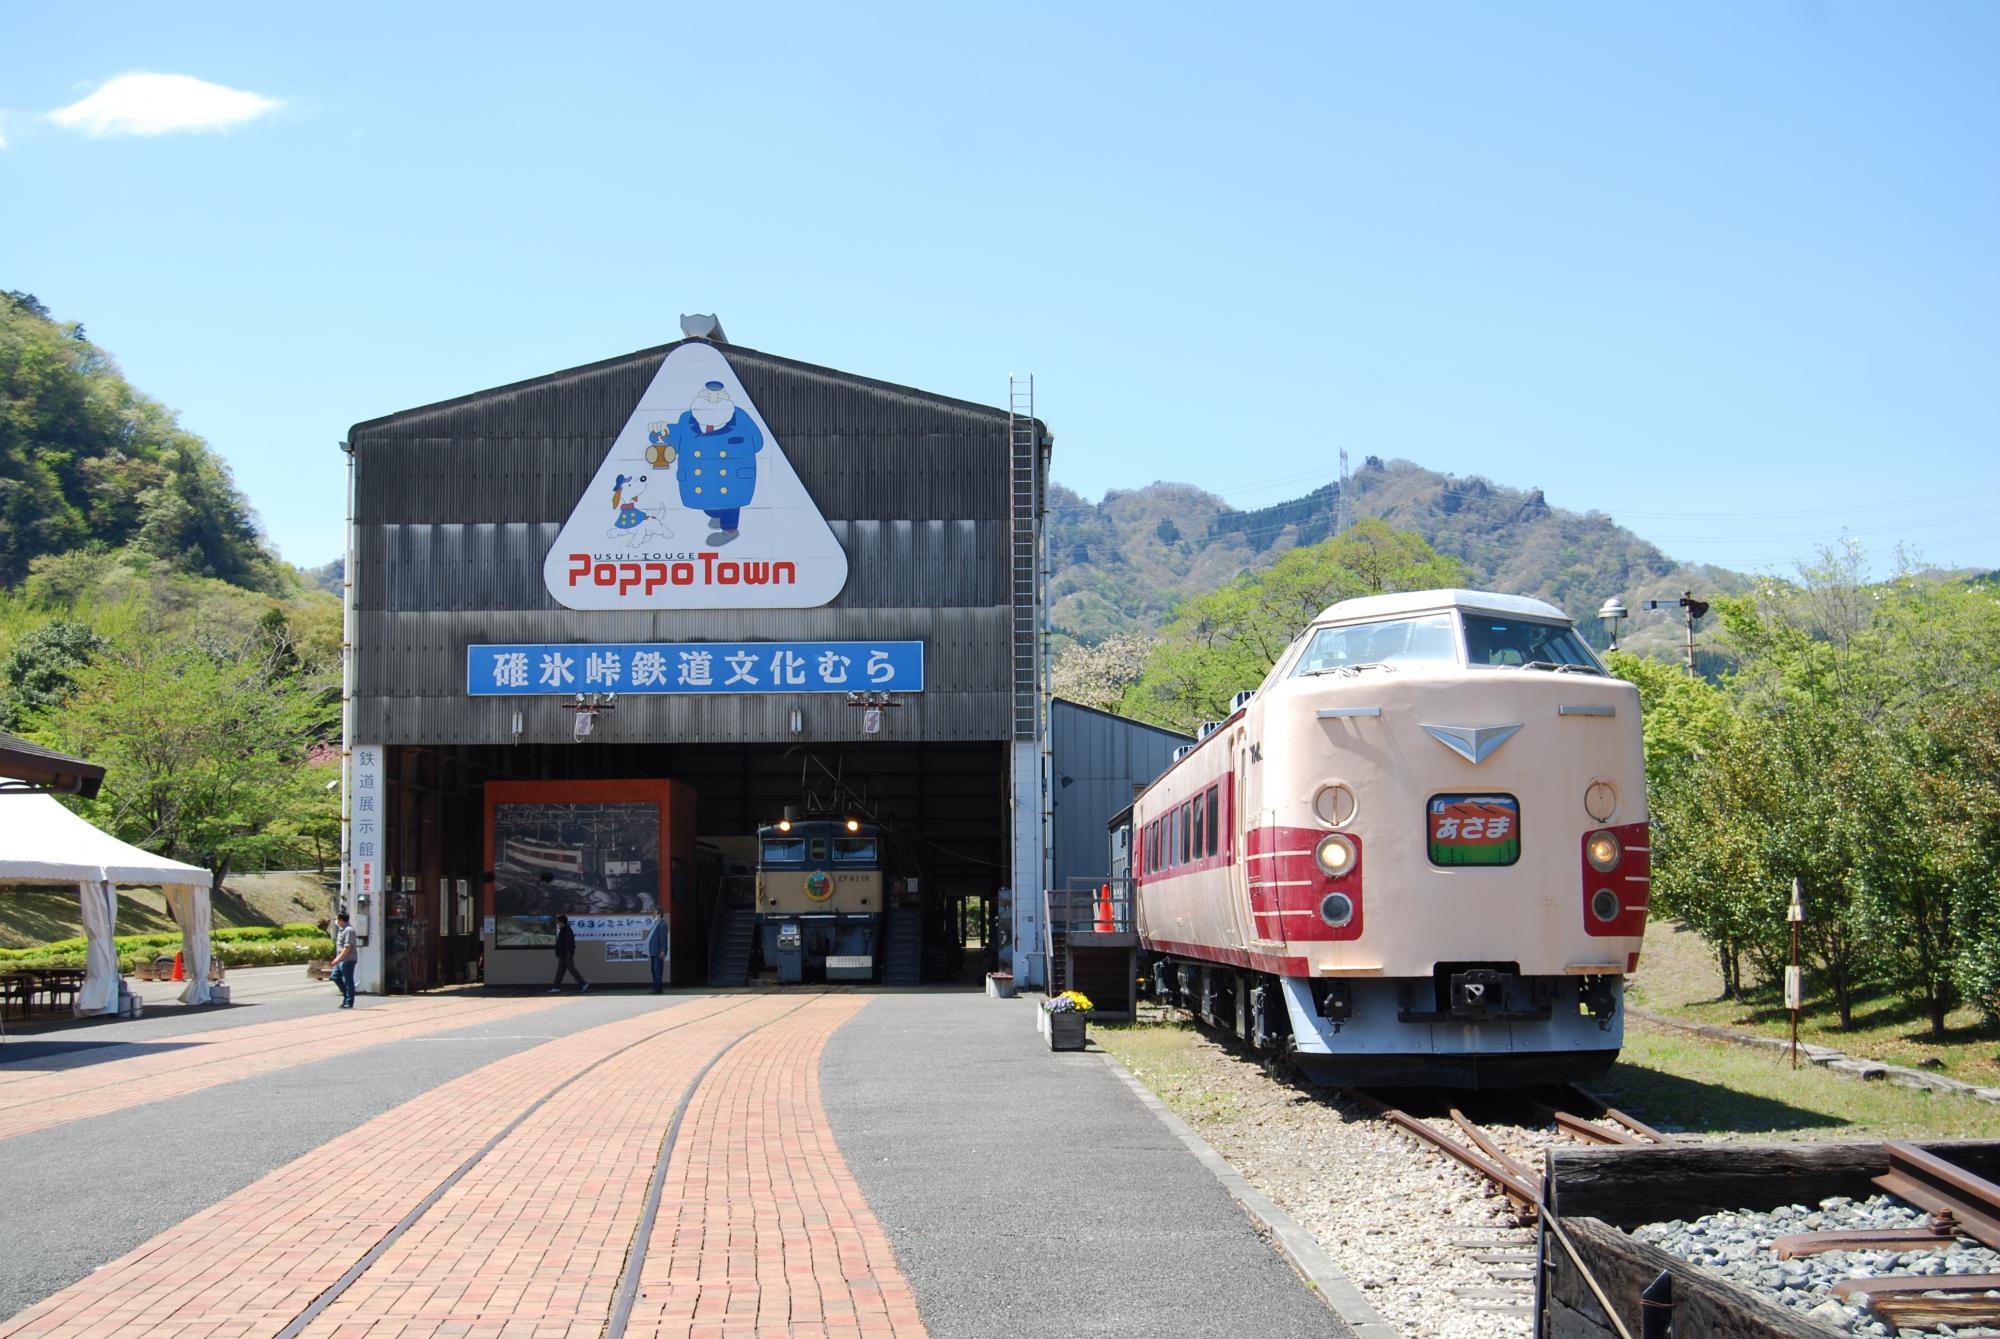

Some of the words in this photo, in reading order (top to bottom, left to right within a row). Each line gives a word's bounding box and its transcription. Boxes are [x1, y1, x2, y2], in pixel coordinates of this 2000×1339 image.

[593, 552, 695, 560] USUI-TOUGE
[492, 650, 897, 688] 碓氷峠鉄道文化むら
[359, 751, 374, 857] 鉄道展示館
[1436, 817, 1510, 839] あさま
